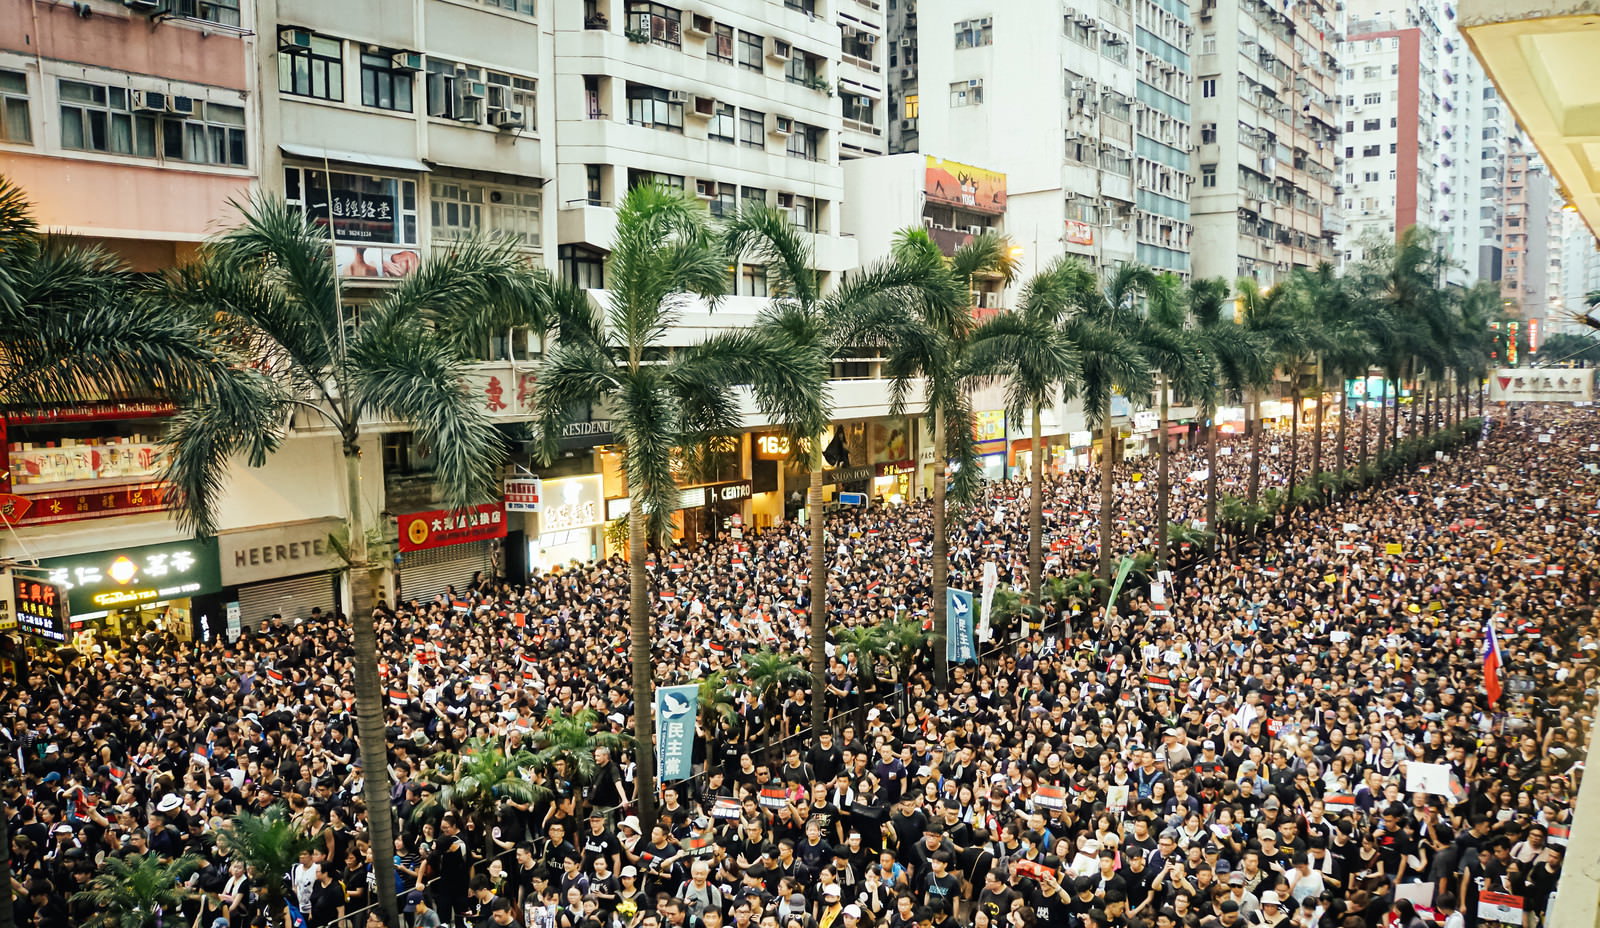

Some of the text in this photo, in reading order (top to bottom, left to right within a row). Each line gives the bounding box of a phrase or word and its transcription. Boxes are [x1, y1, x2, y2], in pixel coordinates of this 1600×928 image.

[832, 469, 870, 482] SALON ICON
[721, 484, 751, 501] CENTRO
[665, 722, 684, 776] 民主黨
